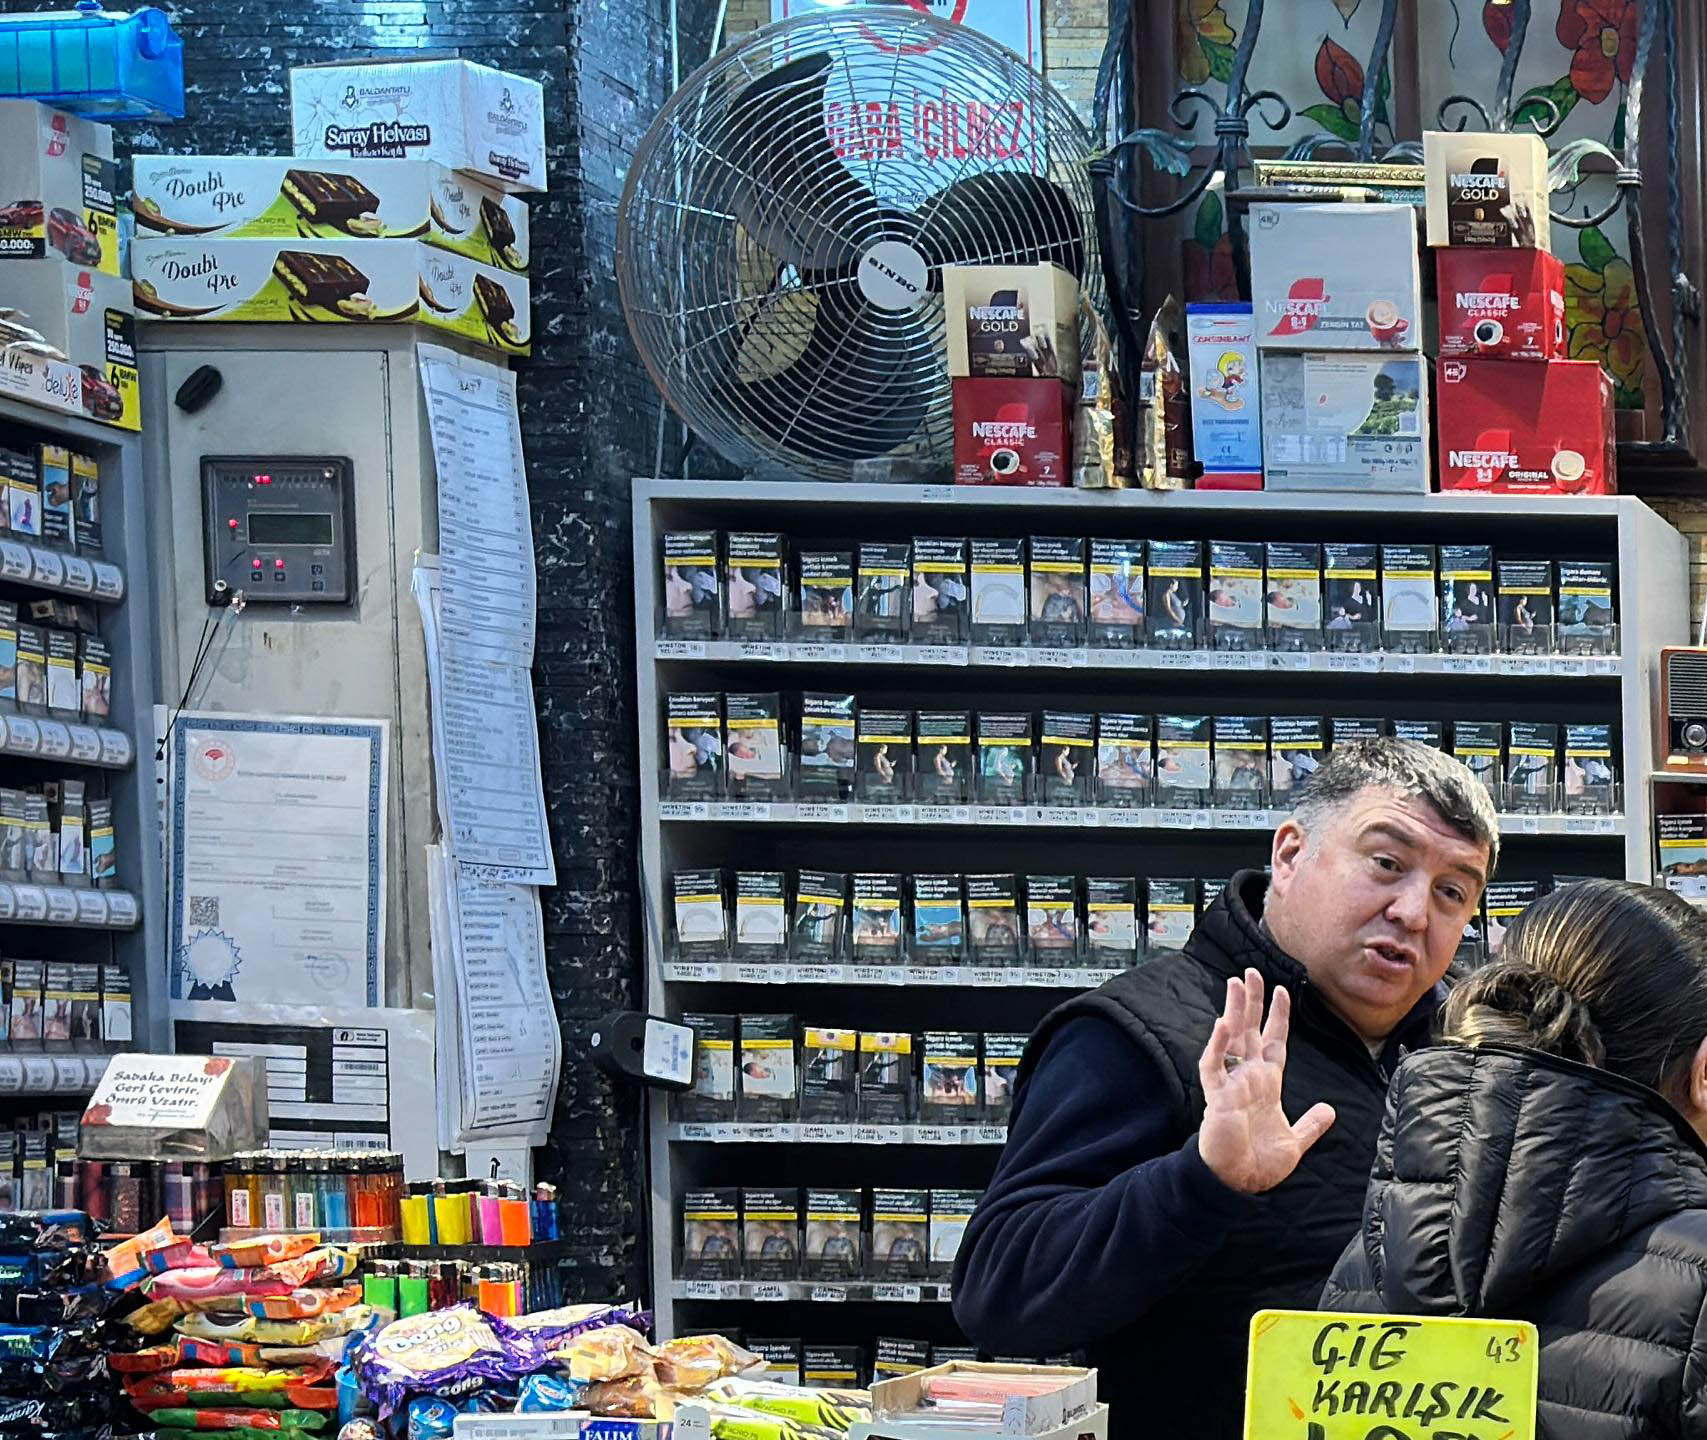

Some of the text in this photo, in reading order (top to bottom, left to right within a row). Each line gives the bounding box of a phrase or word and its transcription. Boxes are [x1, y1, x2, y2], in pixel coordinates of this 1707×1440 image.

[327, 125, 428, 146] Saray Helvası
[166, 171, 246, 212] Doubi Pie
[1460, 188, 1500, 200] GOLD
[162, 252, 239, 294] Doubi Pie
[868, 256, 920, 293] SINBO
[980, 320, 1019, 333] GOLD
[9, 355, 33, 376] Wipes
[110, 365, 120, 390] 6
[115, 1083, 146, 1093] Geri
[105, 1093, 147, 1105] Ömrü
[1485, 1334, 1523, 1364] 43
[1312, 1380, 1512, 1429] KARIŞIK
[680, 1419, 692, 1428] 24
